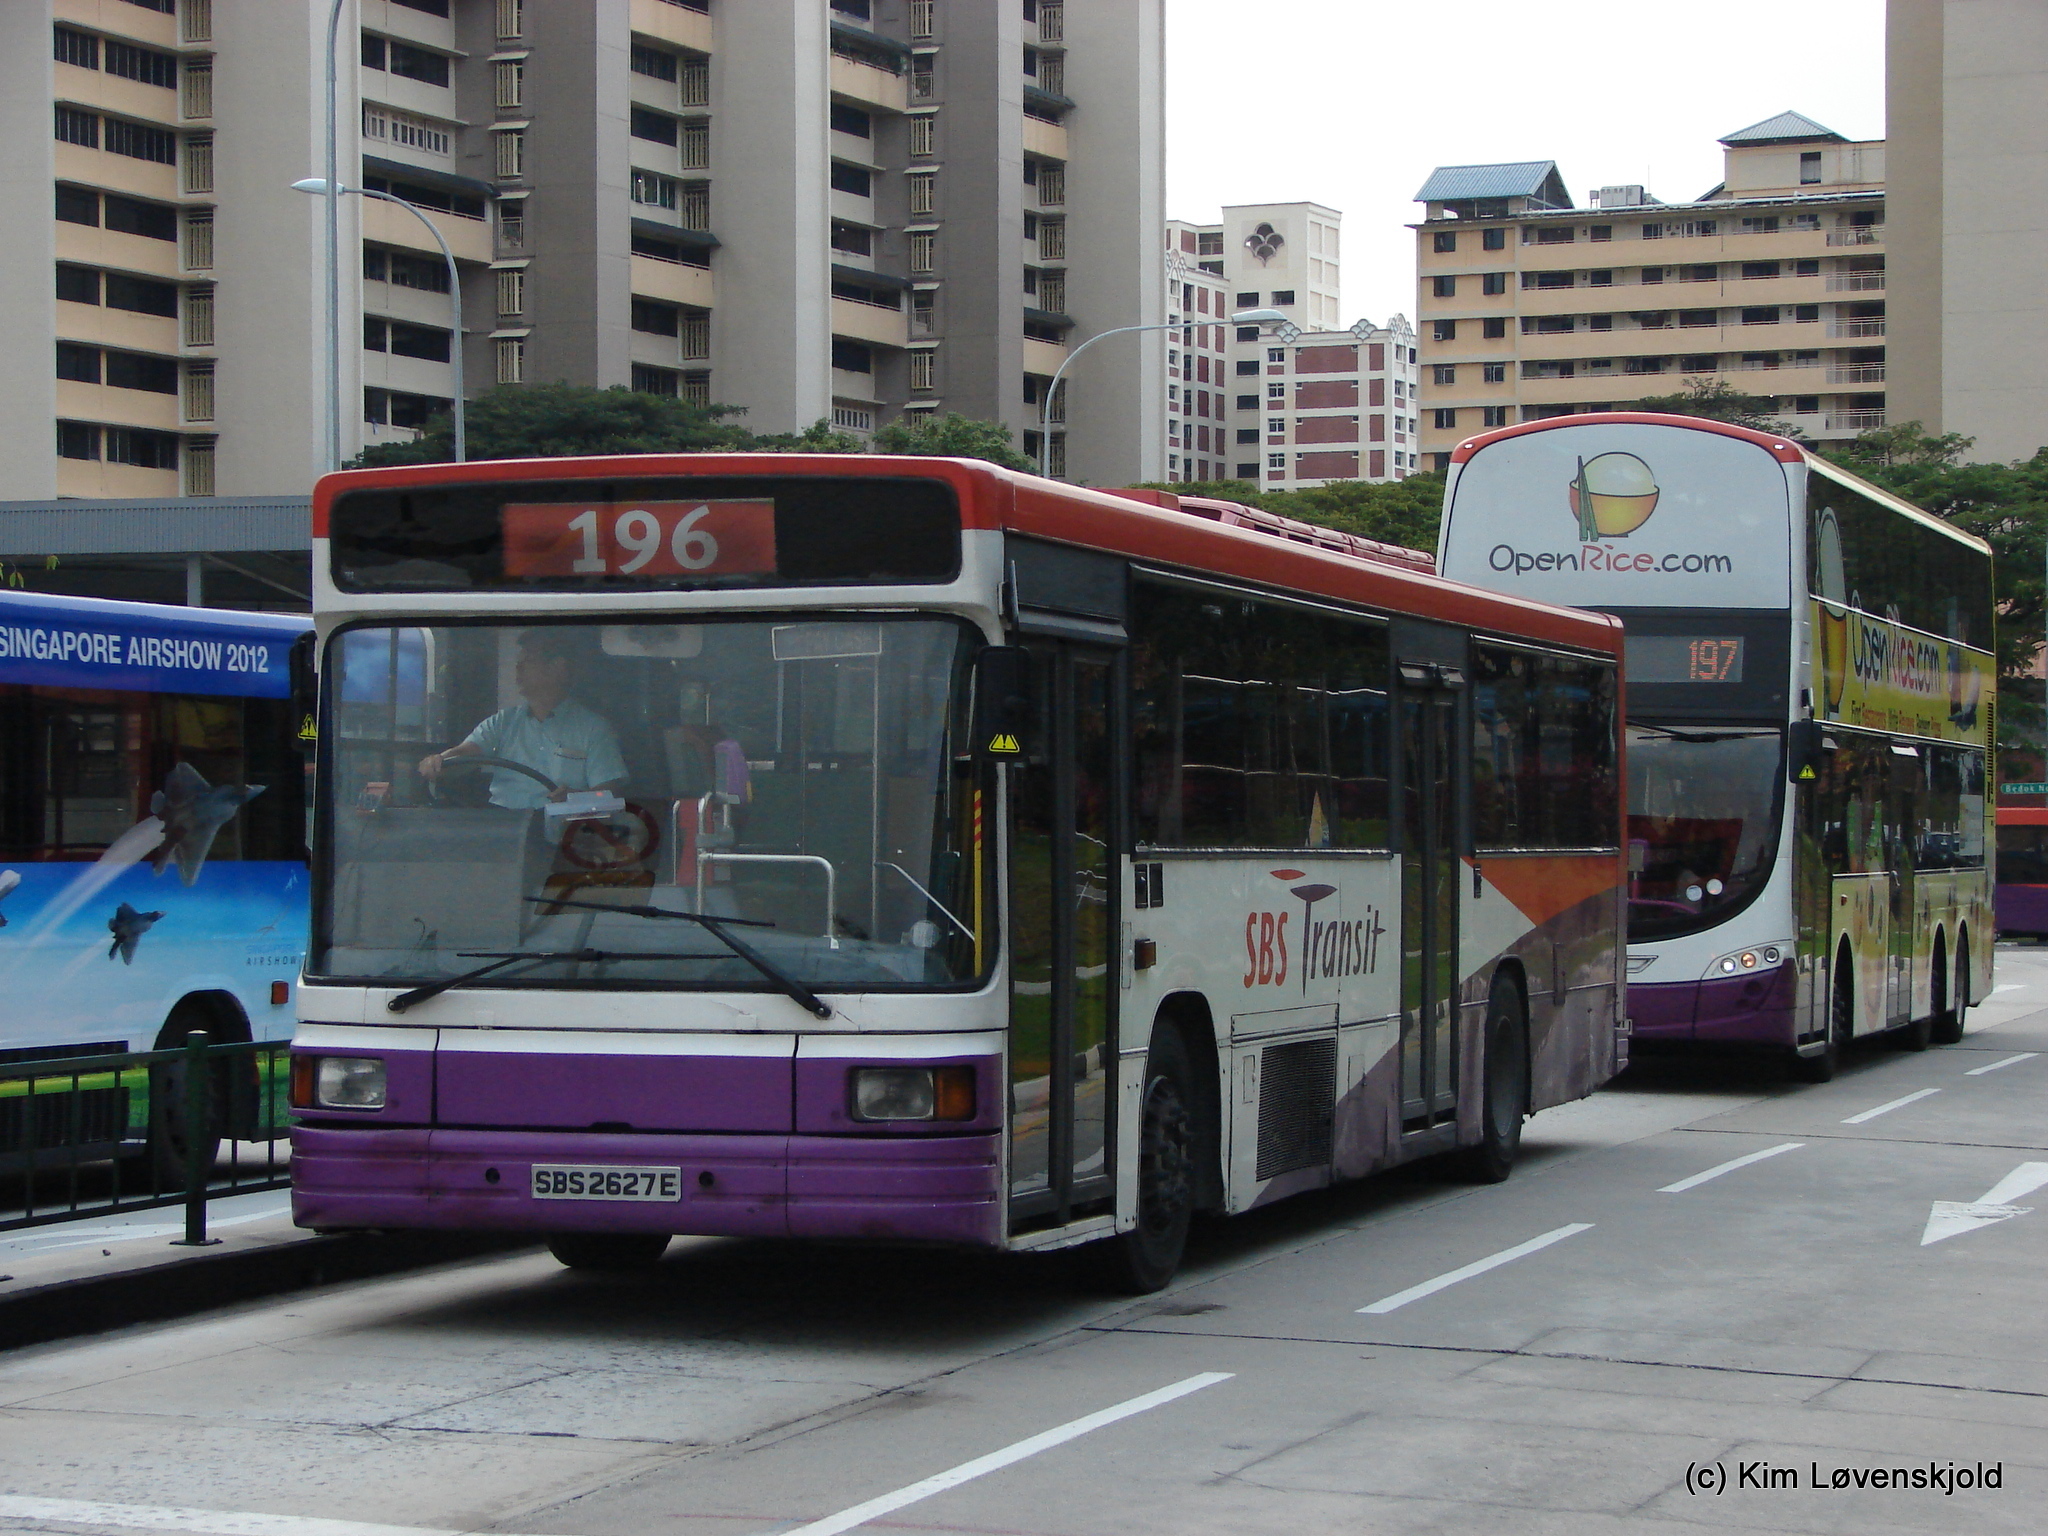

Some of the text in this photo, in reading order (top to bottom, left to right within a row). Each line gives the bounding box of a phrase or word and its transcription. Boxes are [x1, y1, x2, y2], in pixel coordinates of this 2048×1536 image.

[568, 504, 719, 575] 196
[1489, 544, 1732, 576] OpenRice.com
[0, 626, 269, 673] SINGAPORE AIRSHOW 2012
[1689, 640, 1738, 680] 197
[1852, 590, 1941, 696] OpenRice.com
[2005, 784, 2035, 793] Bedok
[245, 955, 298, 967] AIRSHOW
[1244, 884, 1386, 998] SBS Transit
[535, 1170, 677, 1196] SBS2627E
